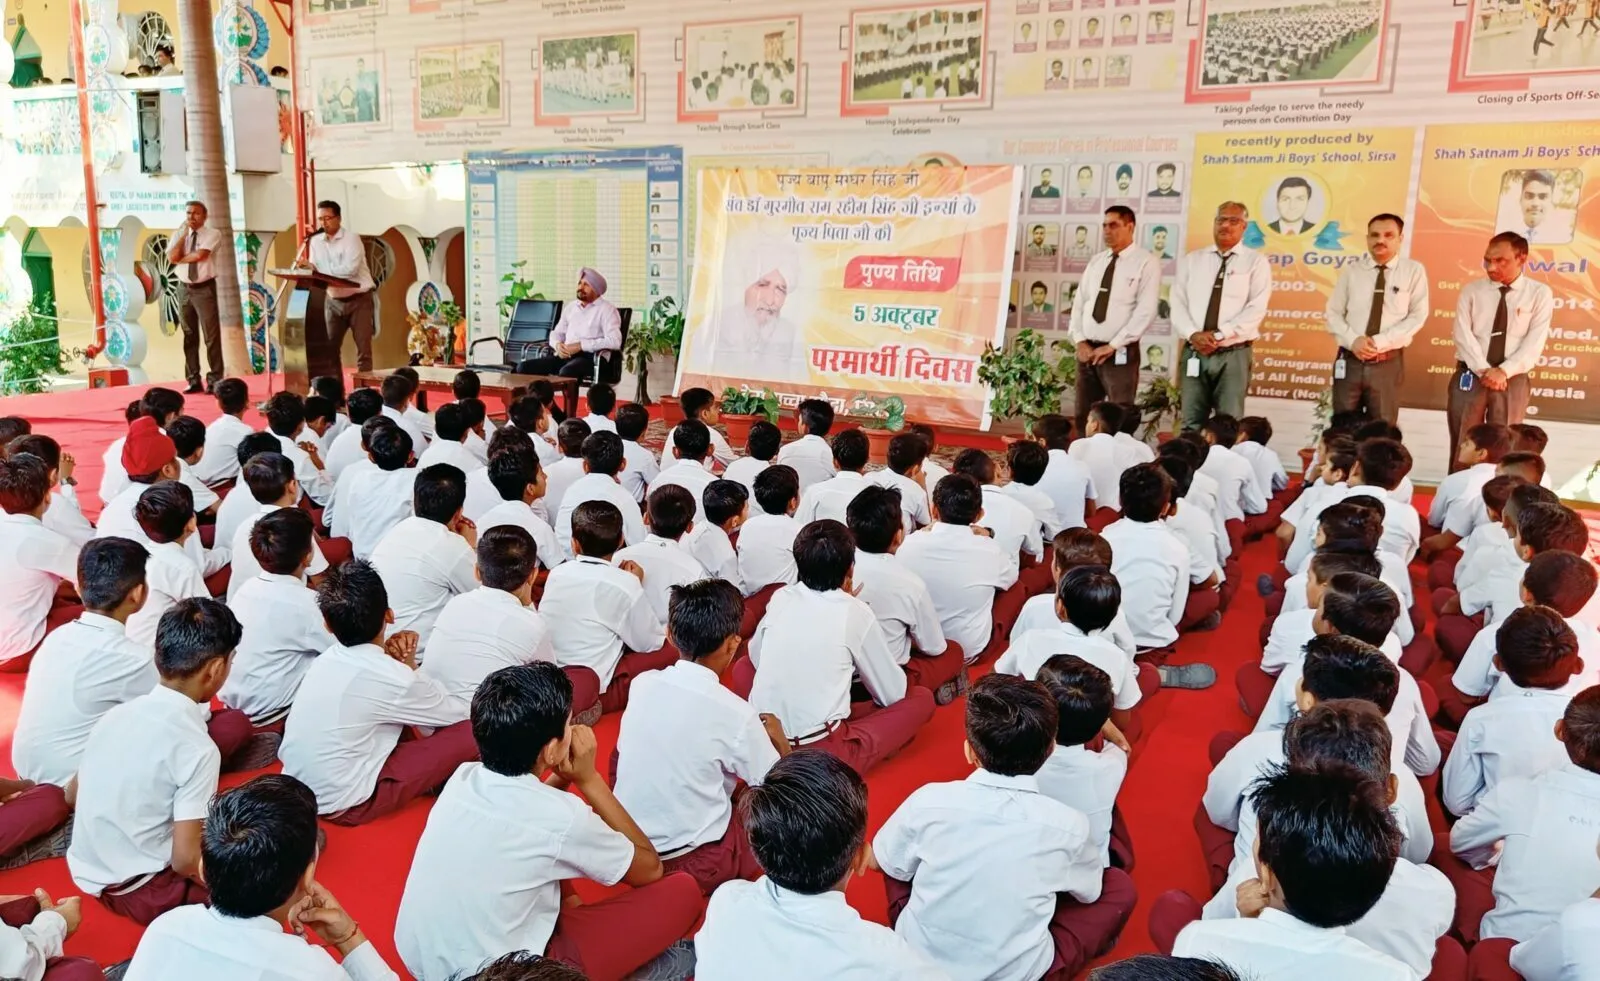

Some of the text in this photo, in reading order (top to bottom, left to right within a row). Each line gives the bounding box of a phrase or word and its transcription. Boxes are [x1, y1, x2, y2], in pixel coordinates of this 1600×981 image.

[1477, 90, 1600, 104] Closing of Sports Off-Se
[1214, 104, 1243, 114] Taking
[1246, 104, 1276, 114] pledge
[1278, 104, 1288, 112] to
[1318, 102, 1333, 110] the
[1336, 100, 1364, 110] needy
[898, 117, 944, 126] Independence
[947, 116, 960, 124] Day
[1222, 118, 1257, 126] persons
[1274, 114, 1331, 124] Constitution
[1333, 114, 1352, 124] Day
[696, 124, 722, 132] Teaching
[723, 124, 746, 132] through
[892, 128, 931, 136] Celebration
[1225, 132, 1374, 148] recently produced by
[1202, 154, 1230, 164] Shah
[1232, 154, 1274, 164] Satnam
[1276, 153, 1286, 164] Ji
[1322, 151, 1363, 163] School,
[1368, 150, 1396, 161] Sirsa
[1434, 148, 1466, 160] Shah
[1469, 147, 1518, 158] Satnam
[1522, 146, 1534, 158] Ji
[776, 174, 802, 190] पूज्य
[806, 174, 830, 190] बापू
[872, 167, 896, 186] सिंह
[902, 168, 920, 186] जी
[764, 196, 805, 216] गुरमीत
[810, 199, 832, 214] राम
[836, 196, 868, 214] रहीम
[872, 196, 896, 214] सिंह
[902, 196, 918, 214] जी
[963, 196, 976, 215] के
[792, 222, 892, 243] पूज्य पिता जी की
[1268, 253, 1294, 268] ap
[860, 260, 944, 287] पुण्य तिथि
[1271, 281, 1316, 292] 2003
[1438, 281, 1462, 290] Got
[1552, 298, 1594, 310] 014
[854, 305, 938, 330] 5 अक्टूबर
[1265, 309, 1329, 320] mmerc
[1434, 309, 1456, 318] Pas
[1264, 321, 1296, 330] Exam
[1254, 332, 1284, 342] 17
[1252, 348, 1294, 356] ursuing
[812, 345, 976, 384] परमार्थी दिवस
[1264, 357, 1333, 371] Gurugram
[1538, 356, 1577, 368] 020
[1268, 372, 1286, 382] All
[1290, 374, 1326, 385] India
[1427, 364, 1457, 375] Join
[1540, 370, 1580, 382] Batch
[1256, 386, 1289, 397] Inter
[1530, 386, 1586, 400] wasia
